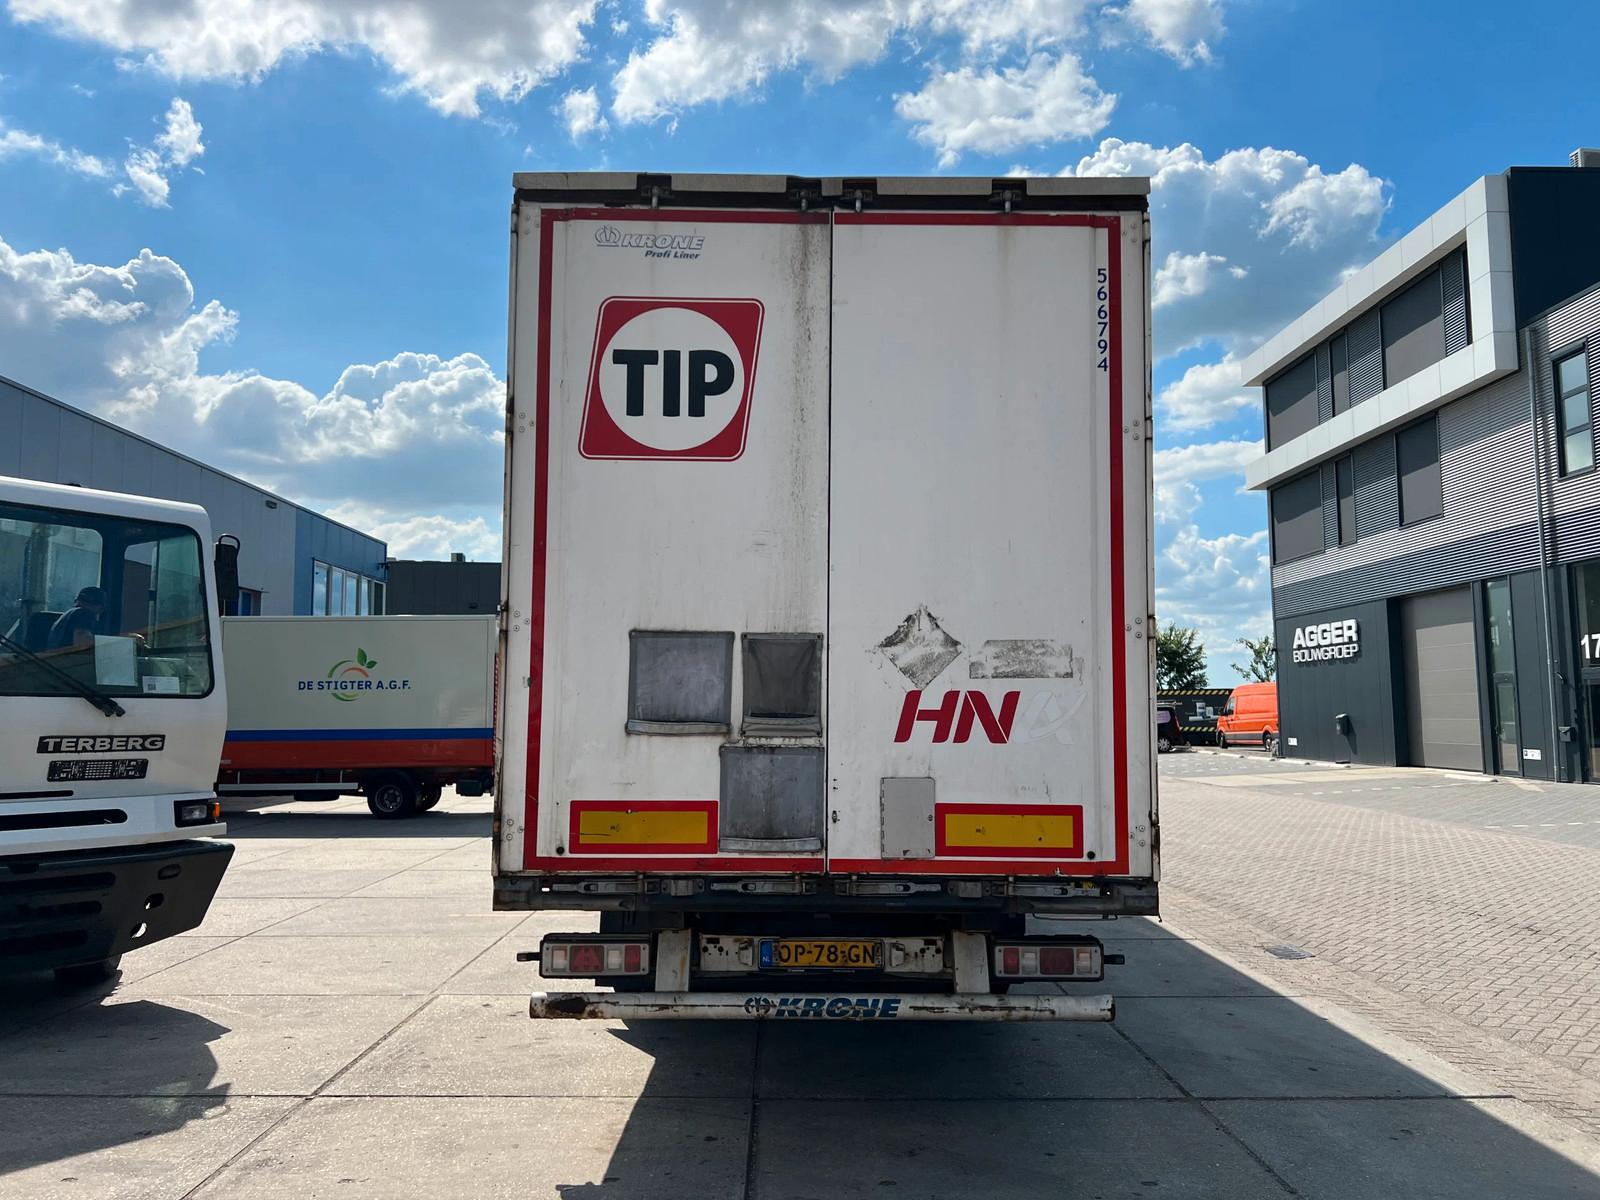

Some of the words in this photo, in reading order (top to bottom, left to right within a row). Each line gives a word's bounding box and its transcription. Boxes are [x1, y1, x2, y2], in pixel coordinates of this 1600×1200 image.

[621, 233, 705, 250] KRONE
[645, 250, 671, 258] Profi
[673, 250, 700, 259] Liner
[1097, 268, 1108, 372] 566794
[612, 349, 735, 417] TIP
[1293, 619, 1358, 649] AGGER
[1293, 643, 1359, 663] BOUWGROEP
[298, 681, 313, 690] DE
[317, 680, 372, 690] STIGTER
[376, 680, 411, 690] A.G.F.
[43, 737, 162, 752] TERBERG
[775, 998, 901, 1018] KRONE
